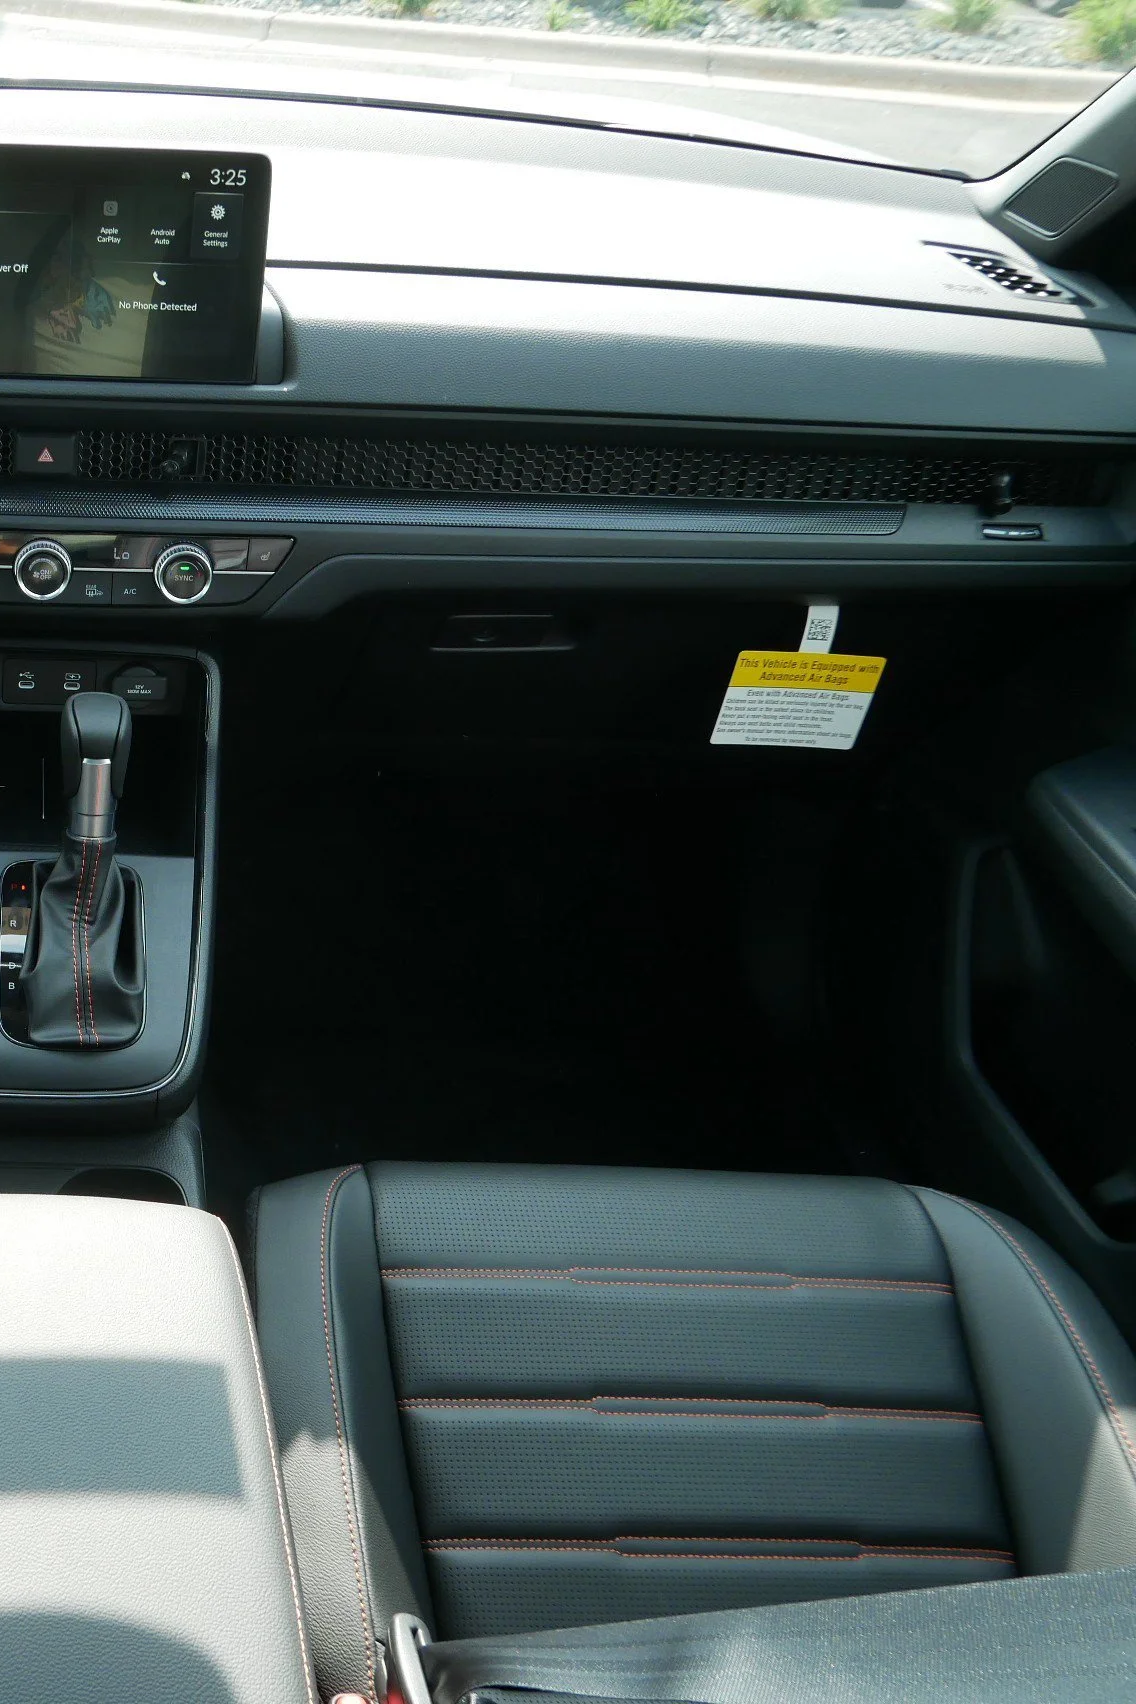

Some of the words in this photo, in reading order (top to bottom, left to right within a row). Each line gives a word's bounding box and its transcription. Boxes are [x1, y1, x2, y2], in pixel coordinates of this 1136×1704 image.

[210, 168, 247, 186] 3:25
[100, 227, 119, 236] Apple
[150, 229, 176, 237] Android
[97, 235, 121, 244] CarPlay
[203, 239, 228, 248] Settings
[13, 263, 29, 273] Off
[119, 301, 131, 309] No
[132, 301, 158, 311] Phone
[160, 302, 197, 312] Detected
[740, 659, 759, 668] This
[762, 659, 798, 669] Vehicle
[812, 661, 856, 673] Equipped
[858, 664, 880, 673] with
[758, 671, 807, 681] Advanced
[808, 674, 823, 682] Air
[825, 674, 849, 685] Bags
[782, 690, 817, 699] Advanced
[9, 982, 16, 990] B
